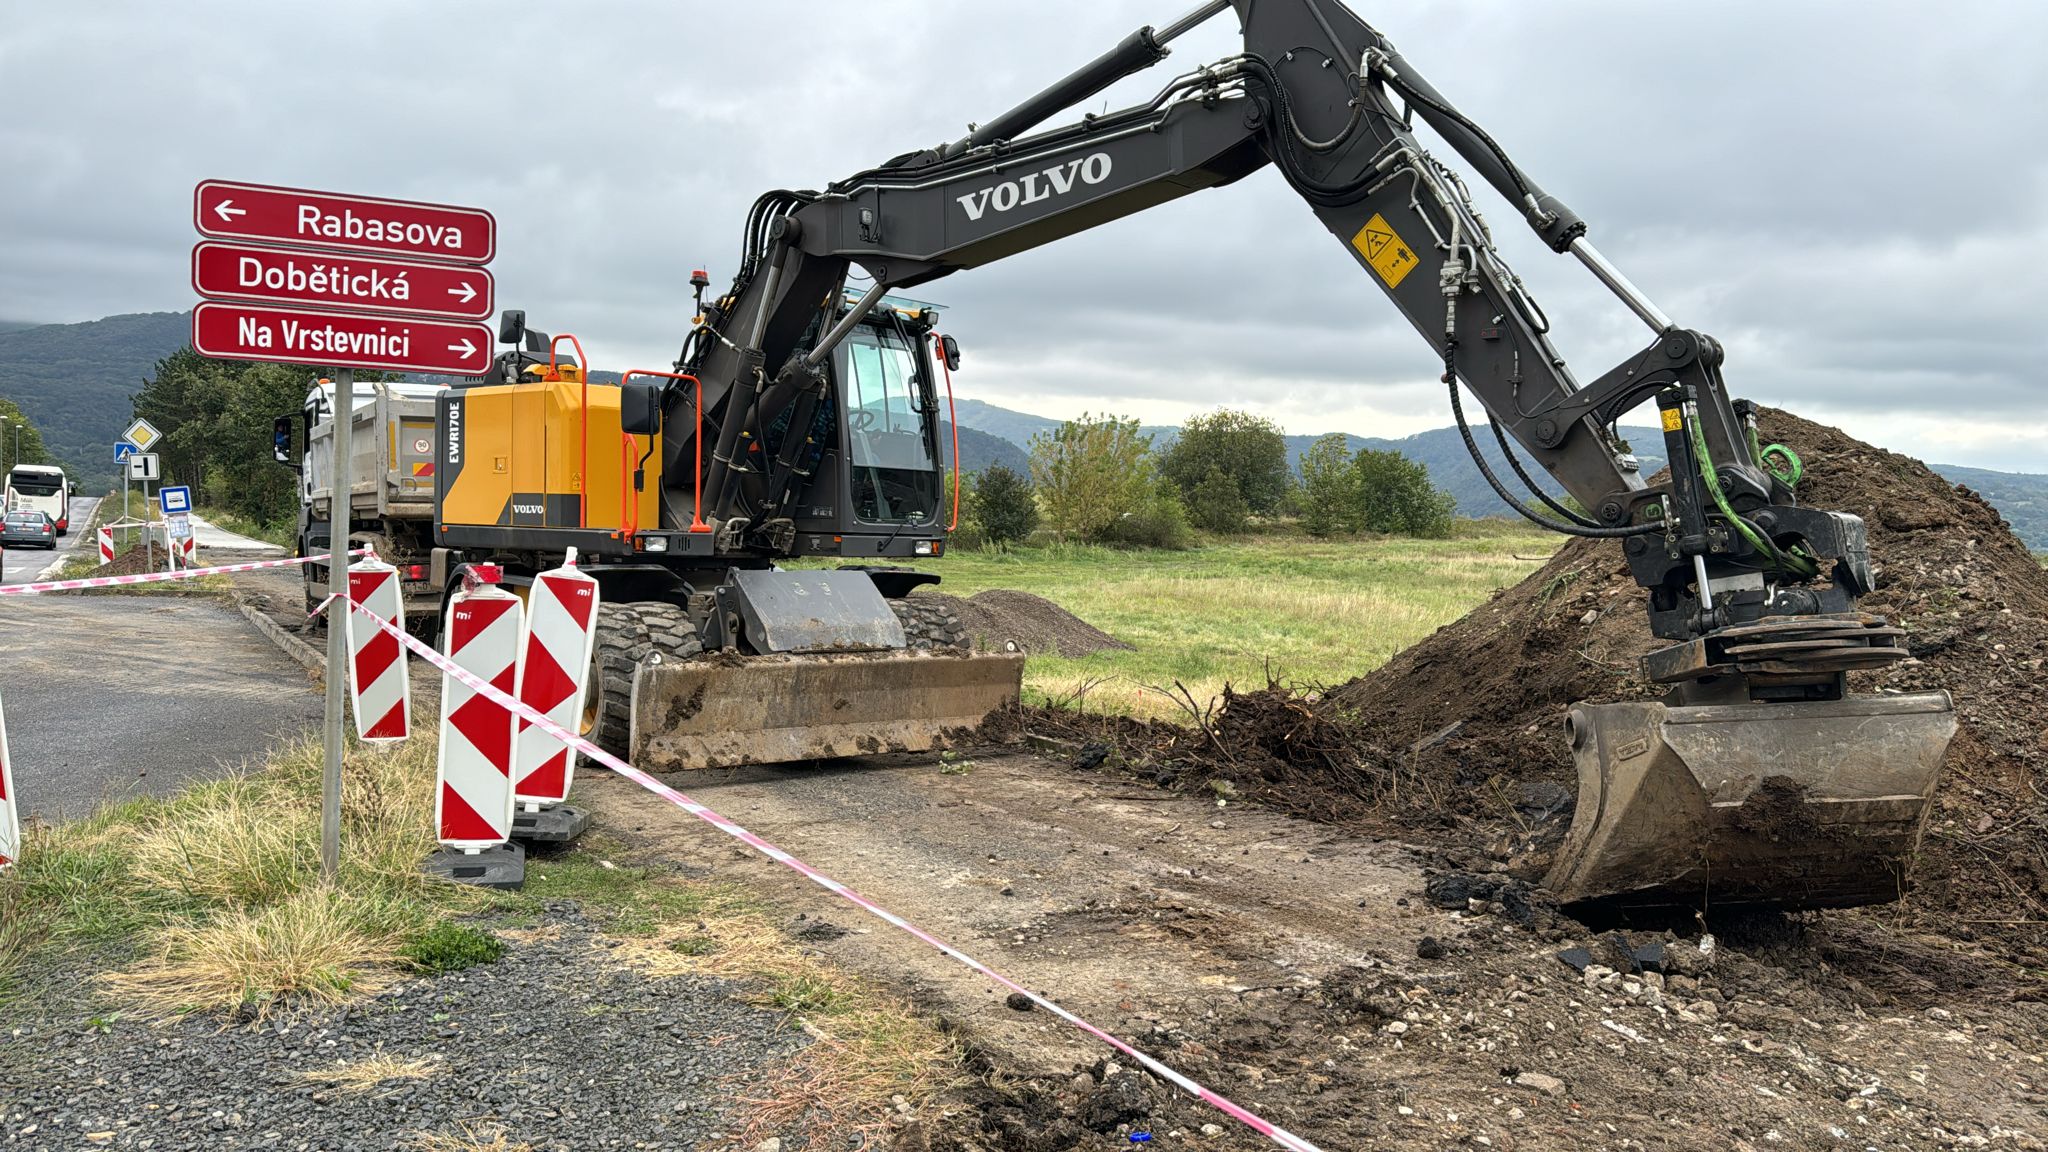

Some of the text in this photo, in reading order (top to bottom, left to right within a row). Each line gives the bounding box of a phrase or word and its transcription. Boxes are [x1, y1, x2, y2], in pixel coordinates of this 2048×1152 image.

[956, 152, 1112, 221] VOLVO
[298, 204, 462, 249] Rabasova
[239, 256, 410, 300] Dobětická
[238, 316, 410, 358] Na Vrstevnici
[448, 401, 460, 464] EWR170E
[512, 504, 544, 514] VOLVO
[576, 587, 592, 597] mi
[455, 611, 472, 621] mi
